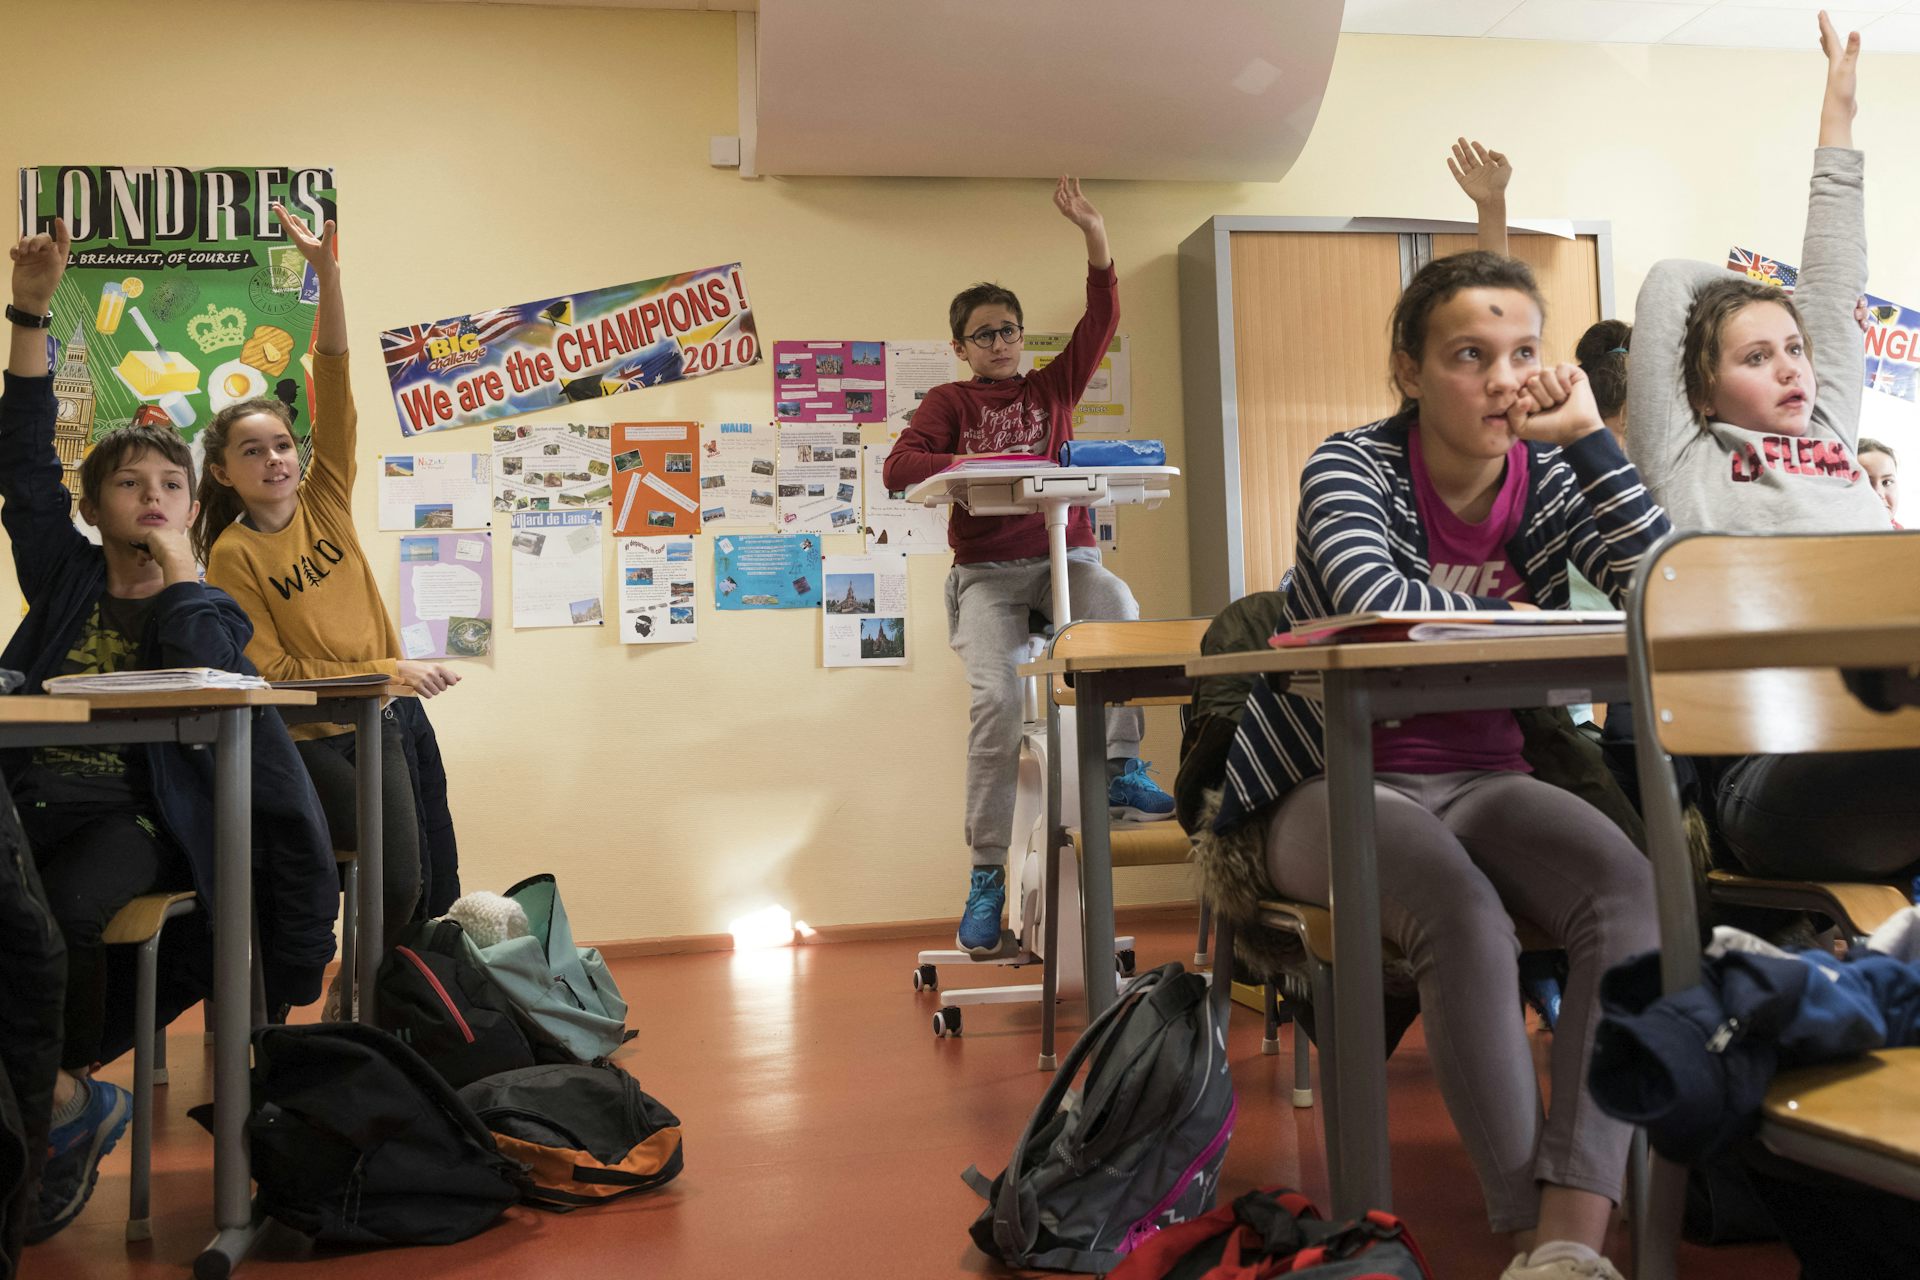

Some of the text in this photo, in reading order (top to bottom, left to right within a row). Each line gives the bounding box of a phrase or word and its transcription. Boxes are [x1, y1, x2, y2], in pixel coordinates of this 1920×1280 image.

[23, 168, 328, 241] LONDRES
[79, 252, 164, 266] BREAKFAST,
[168, 252, 186, 264] OF
[188, 252, 242, 264] COURSE
[444, 326, 457, 336] The
[401, 383, 453, 431] We
[458, 373, 505, 413] are
[505, 346, 555, 394] the
[556, 277, 731, 374] CHAMPIONS
[429, 333, 480, 359] BIG
[682, 335, 755, 375] 2010
[1864, 325, 1920, 364] NGL
[428, 347, 487, 371] challenge
[720, 423, 752, 434] WALIBI
[546, 513, 560, 526] de
[562, 512, 587, 525] Lans
[1427, 560, 1506, 597] NIE
